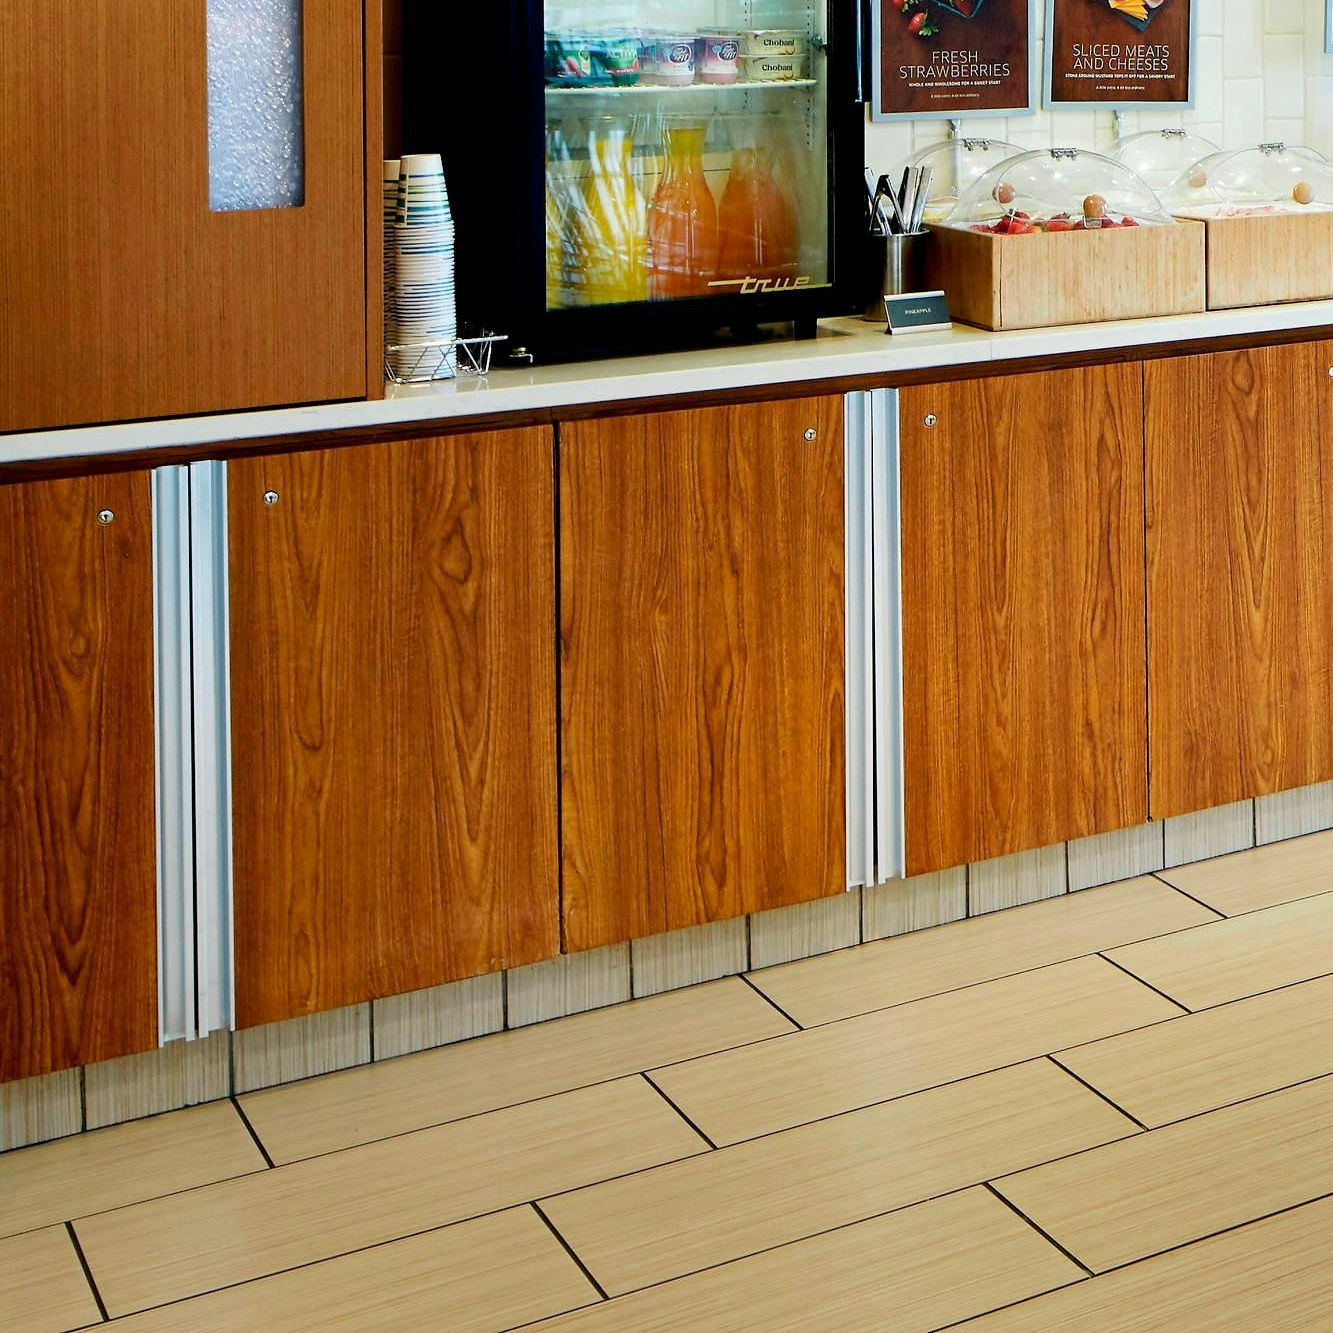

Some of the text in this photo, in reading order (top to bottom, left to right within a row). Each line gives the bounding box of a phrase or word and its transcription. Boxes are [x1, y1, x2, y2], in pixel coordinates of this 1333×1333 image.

[932, 50, 978, 64] FRESH
[1072, 43, 1170, 58] SLICED MEATS
[899, 63, 1011, 79] STRAWBERRIES
[1073, 57, 1169, 70] AND CHEESES
[707, 275, 832, 294] true
